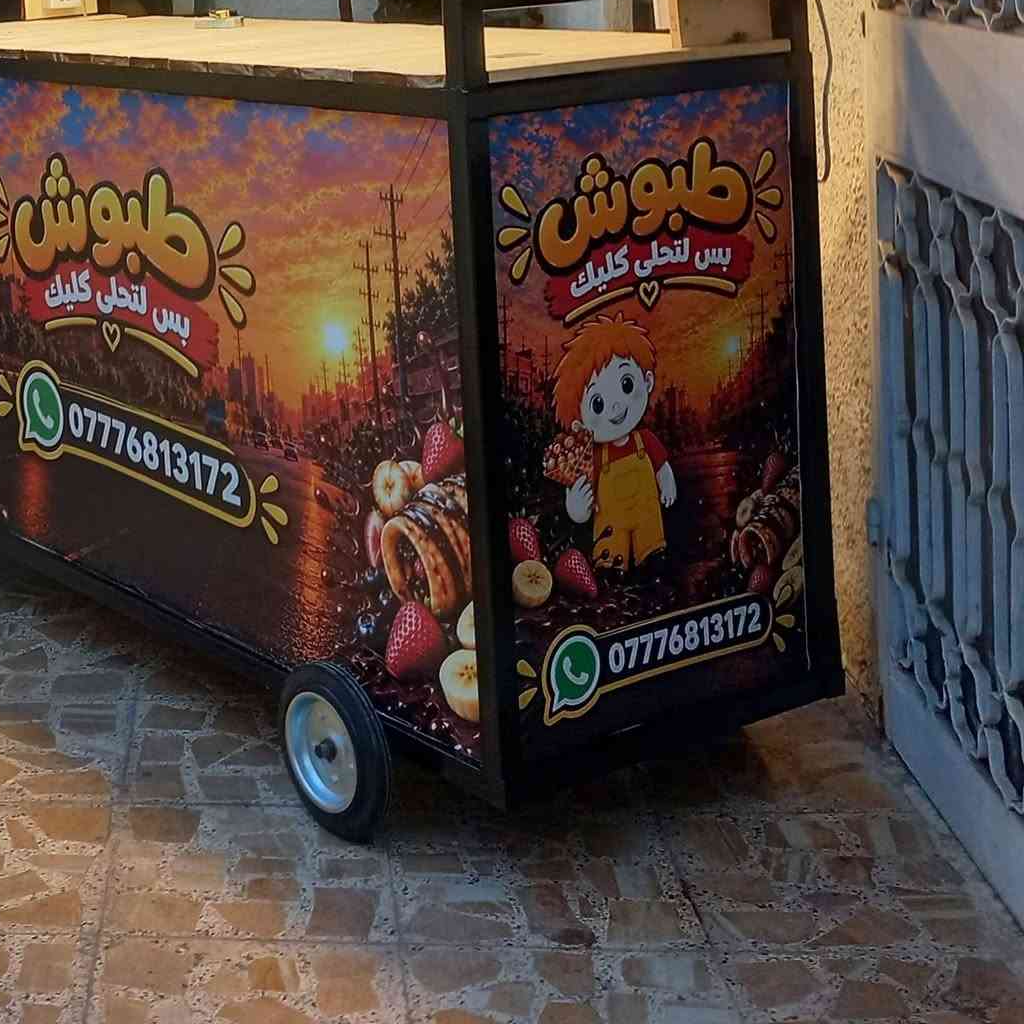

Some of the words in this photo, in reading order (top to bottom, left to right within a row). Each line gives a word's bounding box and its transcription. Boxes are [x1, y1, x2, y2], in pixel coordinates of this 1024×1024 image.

[13, 156, 213, 295] طبوش
[537, 139, 750, 272] طبوش
[45, 269, 93, 311] كليك
[570, 244, 629, 298] كليك
[695, 247, 731, 273] بس
[152, 307, 190, 347] بس
[69, 403, 241, 506] 07776813172
[608, 602, 761, 673] 07776813172
